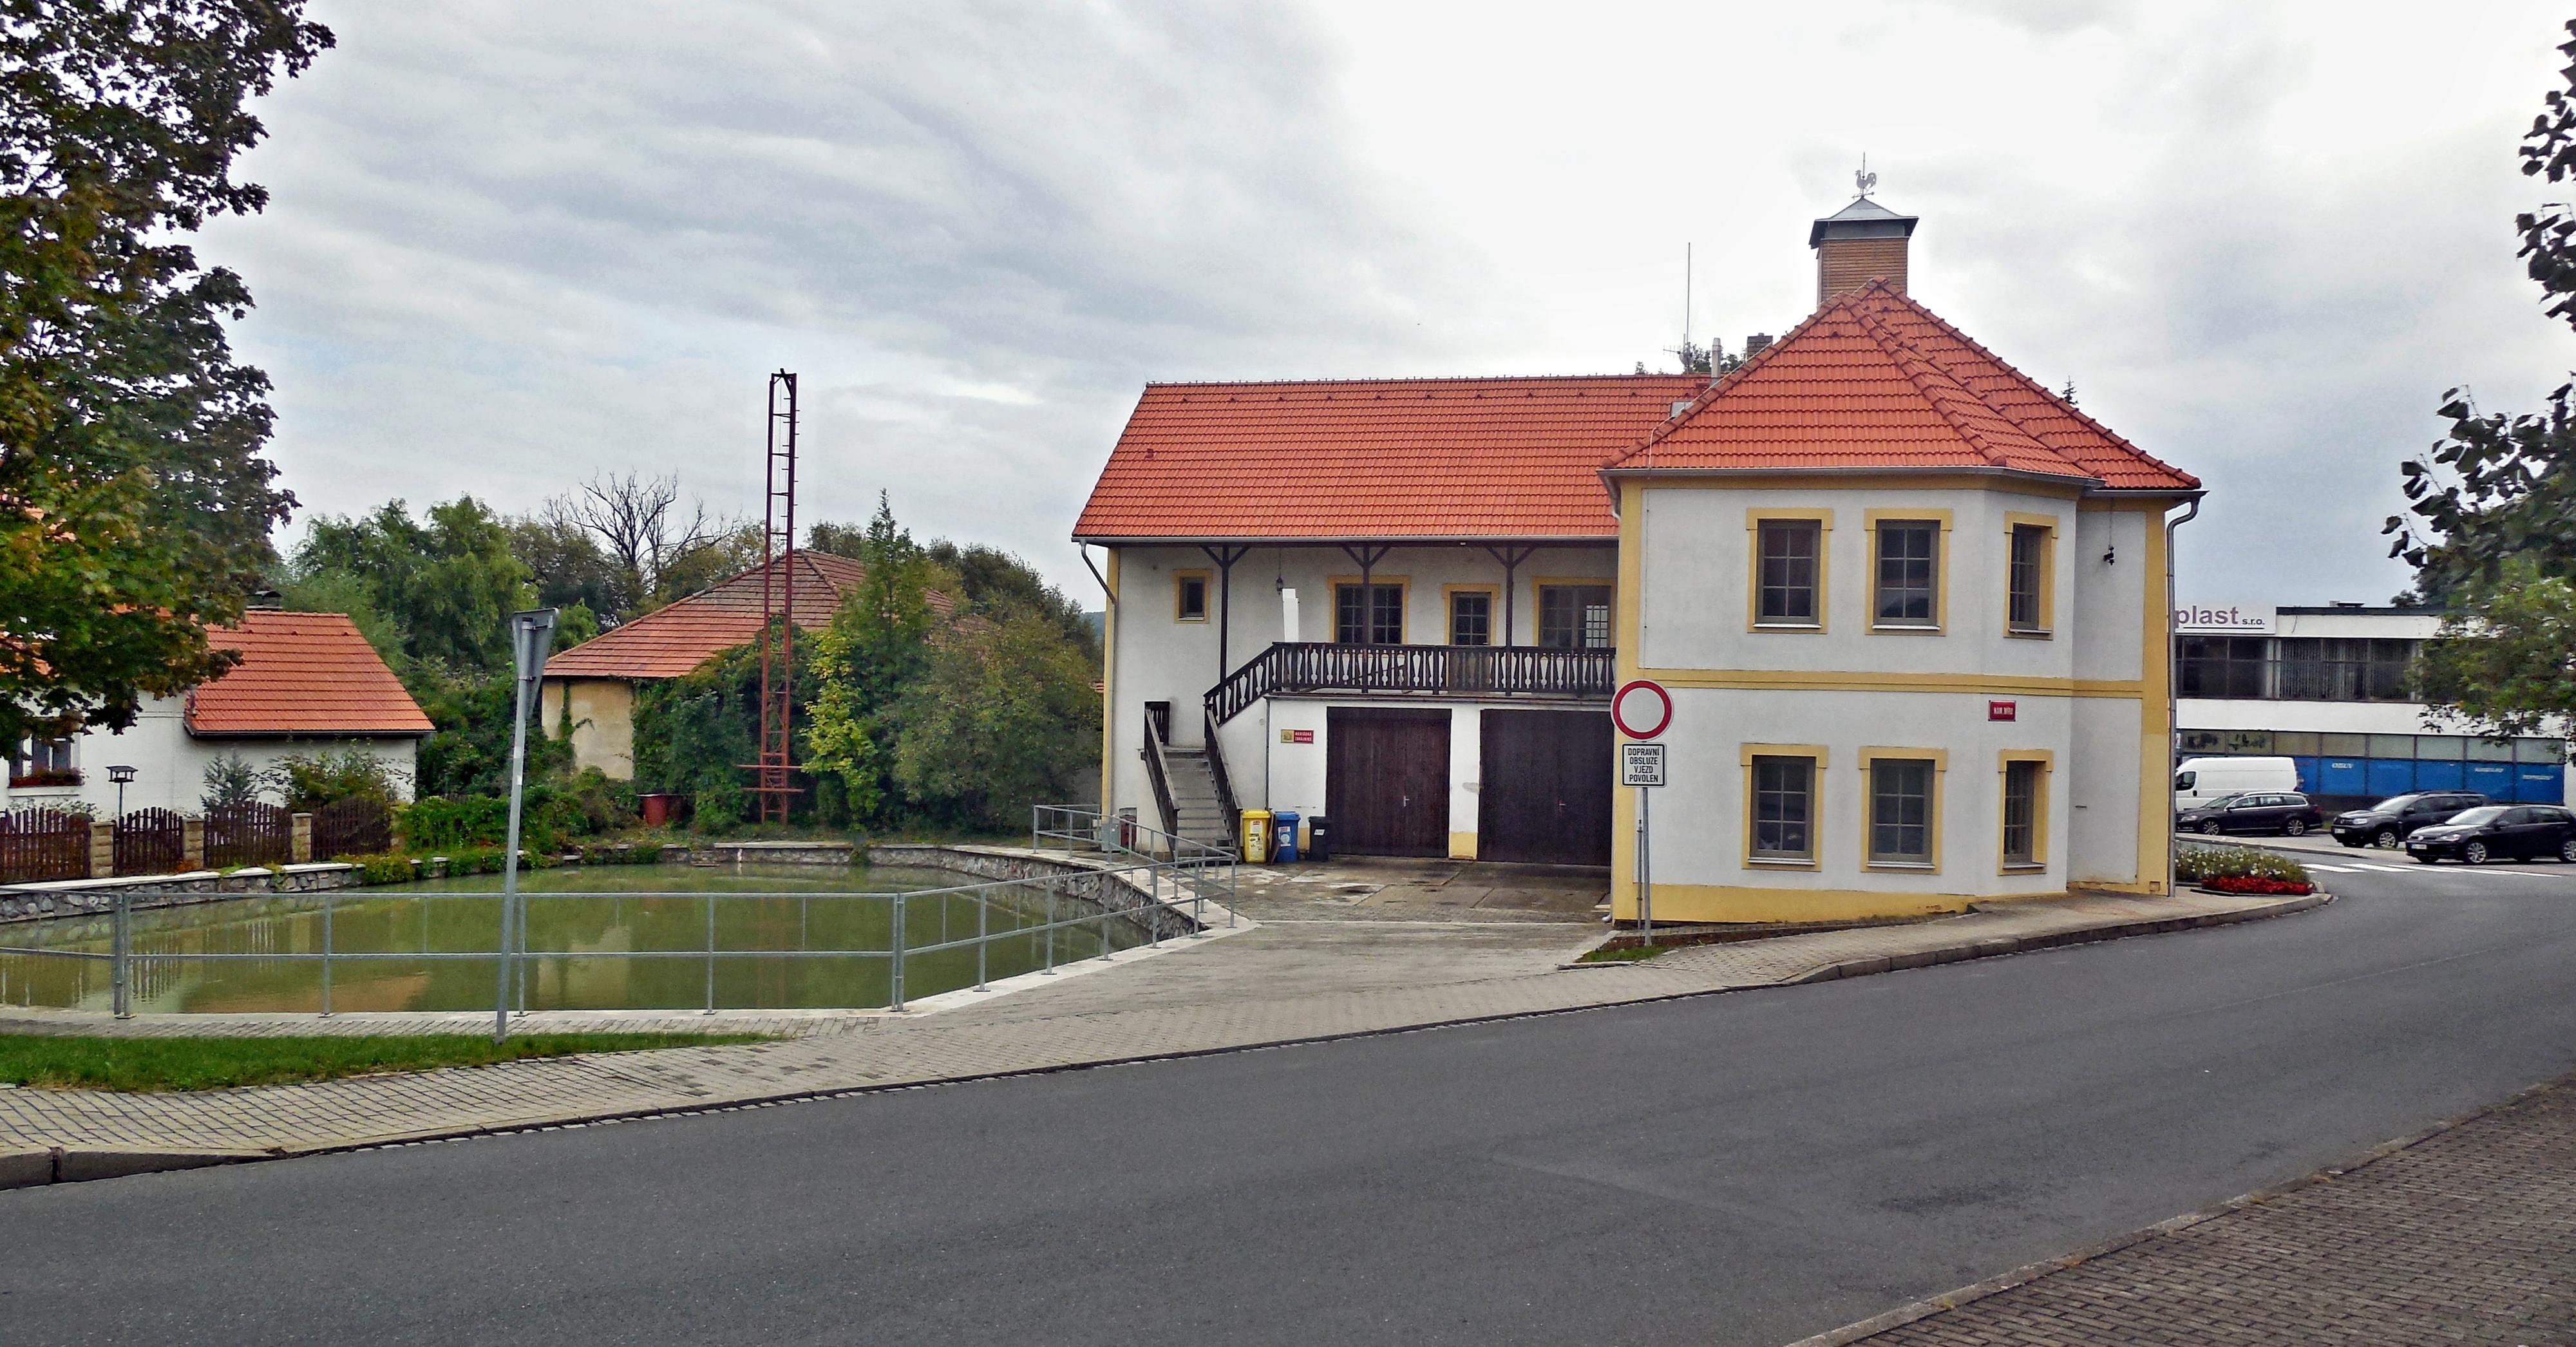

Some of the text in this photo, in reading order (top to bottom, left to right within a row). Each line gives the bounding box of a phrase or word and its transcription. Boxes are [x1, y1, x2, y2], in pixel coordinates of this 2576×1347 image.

[1628, 747, 1660, 755] DOPRAVNÍ
[1629, 757, 1658, 765] OBSLUZE
[1629, 774, 1658, 782] POVOLEN
